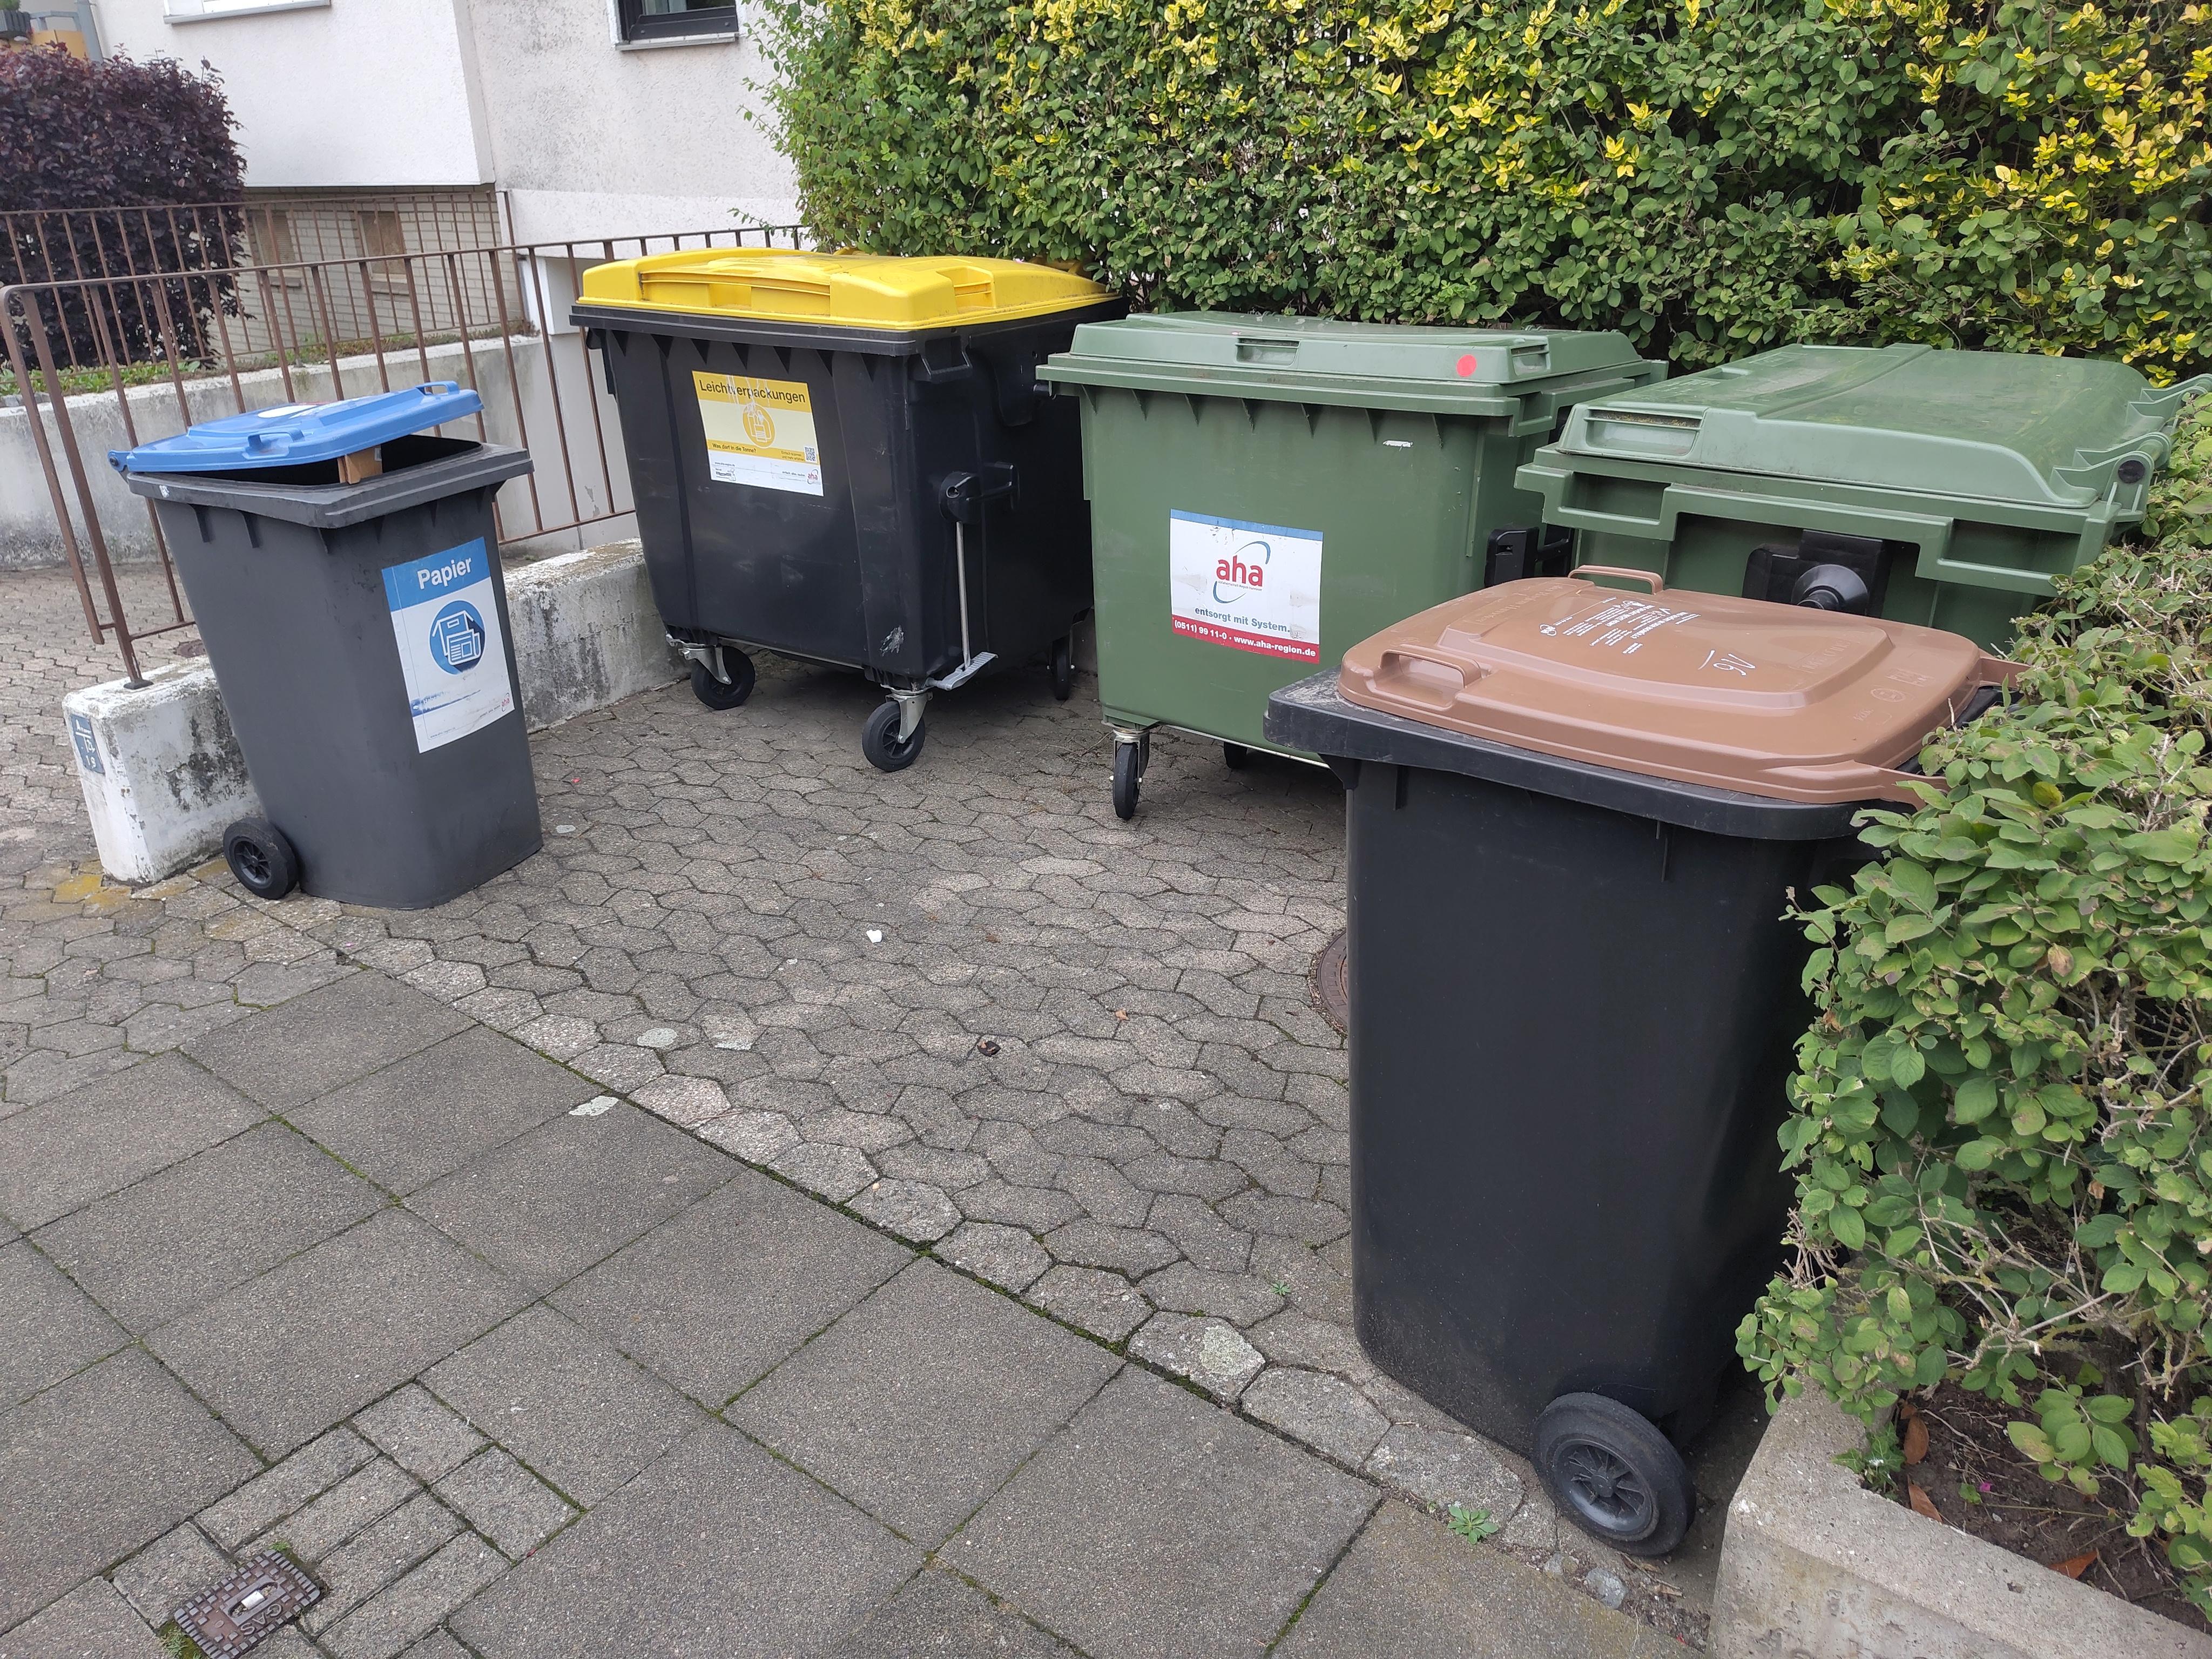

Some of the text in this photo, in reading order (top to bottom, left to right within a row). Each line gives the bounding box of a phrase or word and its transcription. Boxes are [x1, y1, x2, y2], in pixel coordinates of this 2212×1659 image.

[699, 380, 806, 404] Leichtverpackungen
[417, 557, 473, 589] Papier
[1216, 555, 1263, 587] aha
[1195, 607, 1291, 632] entsorgt mit System.
[1175, 619, 1197, 633] (0511)
[1199, 626, 1209, 636] 99
[1210, 629, 1228, 639] 11-0
[1234, 635, 1316, 656] www.aha-region.de
[502, 698, 510, 706] aha
[240, 1603, 282, 1636] GAS
